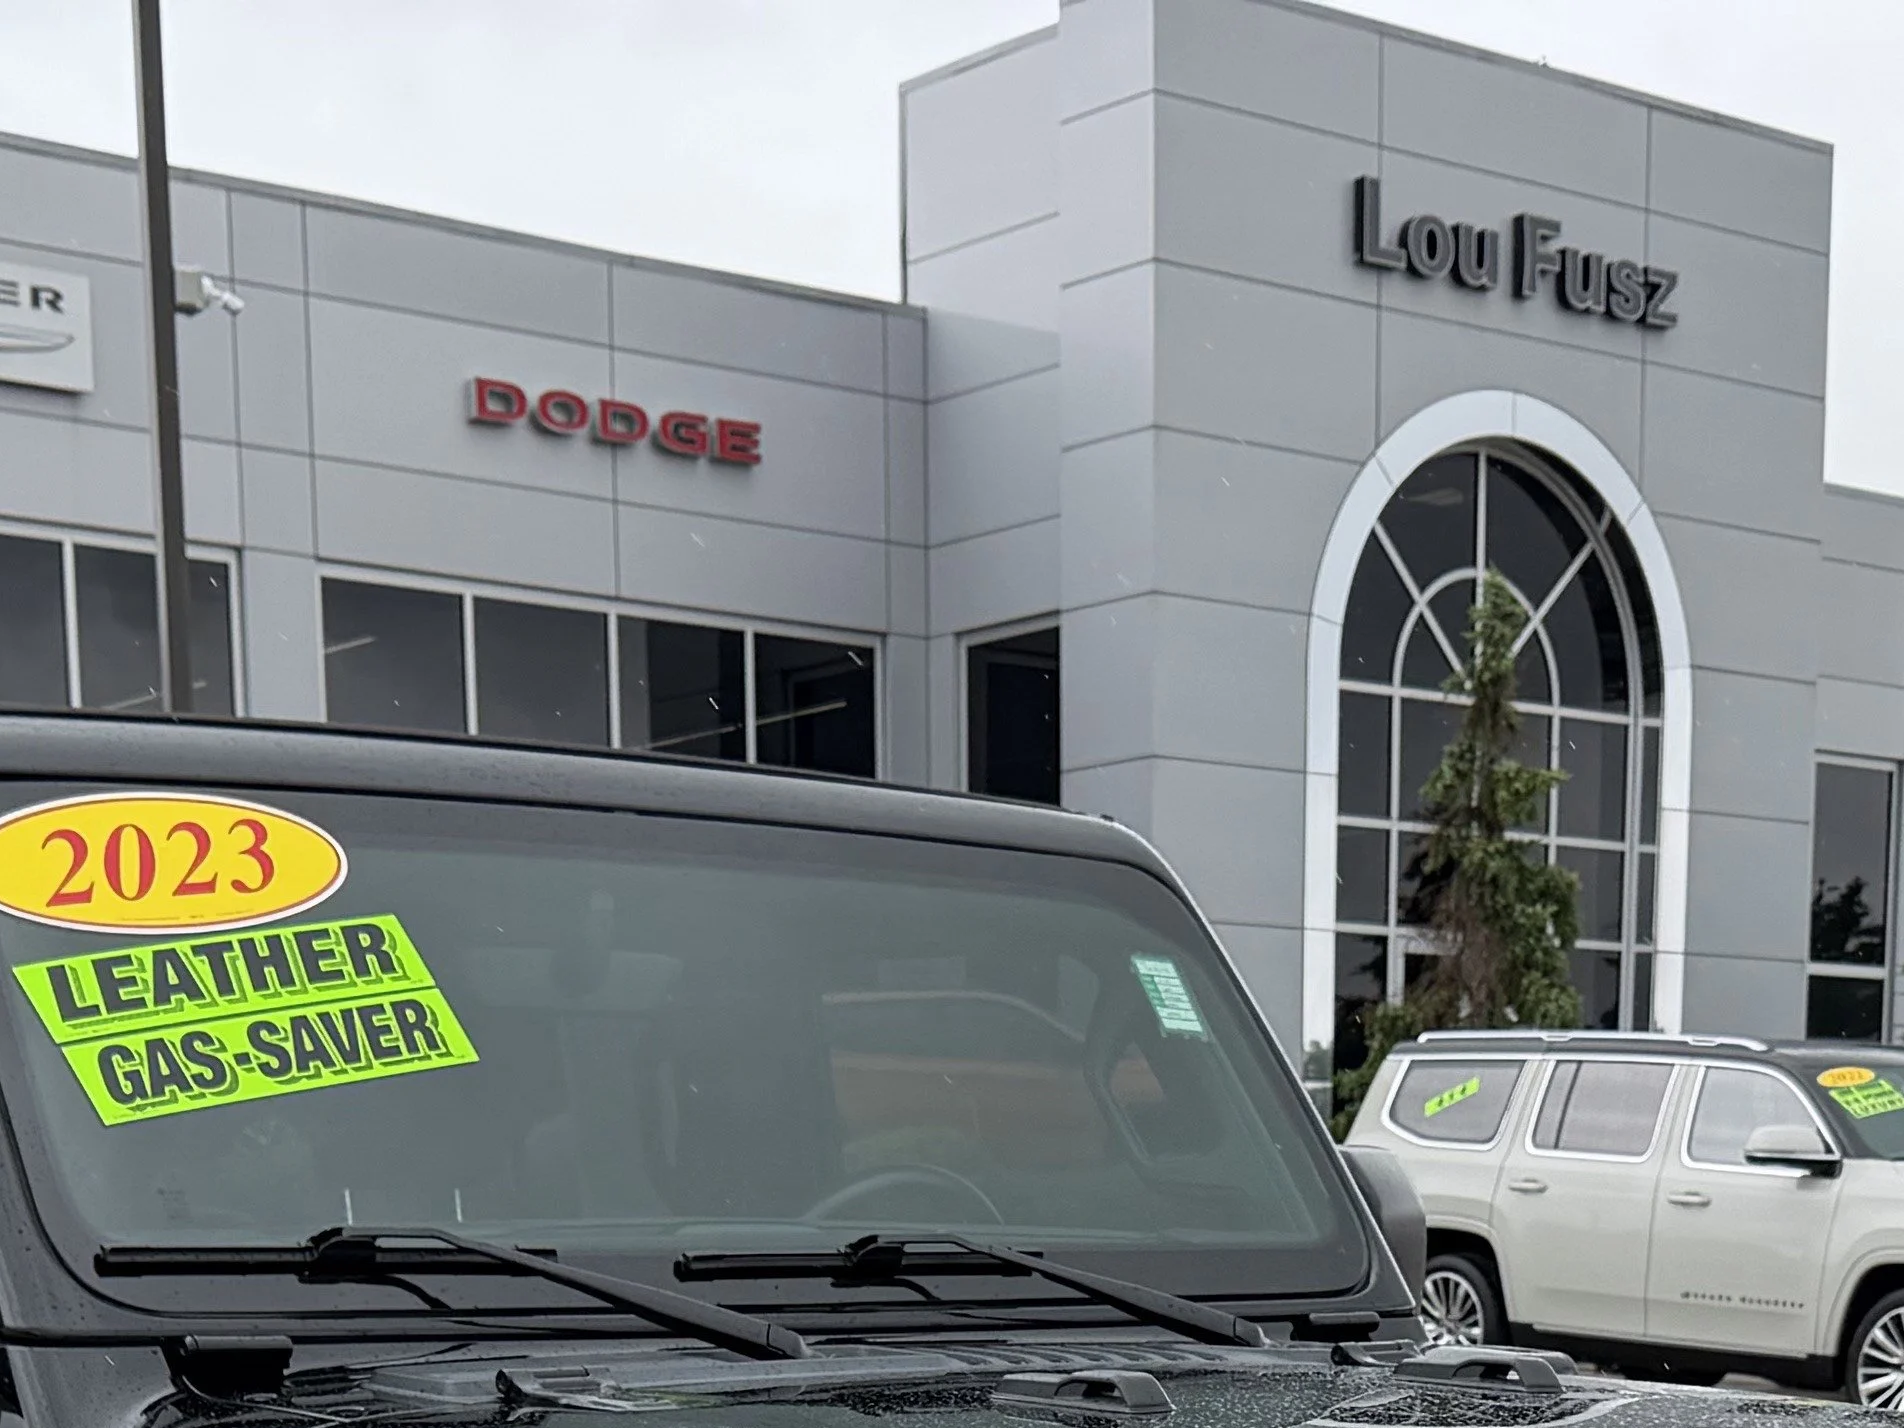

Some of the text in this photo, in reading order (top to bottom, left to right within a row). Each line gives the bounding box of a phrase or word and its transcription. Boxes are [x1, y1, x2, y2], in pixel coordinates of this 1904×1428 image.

[1352, 174, 1680, 329] Lou Fusz
[470, 376, 763, 468] DODGE
[40, 817, 276, 909] 2023
[45, 922, 408, 1028] LEATHER
[96, 997, 454, 1110] GAS-SAVER
